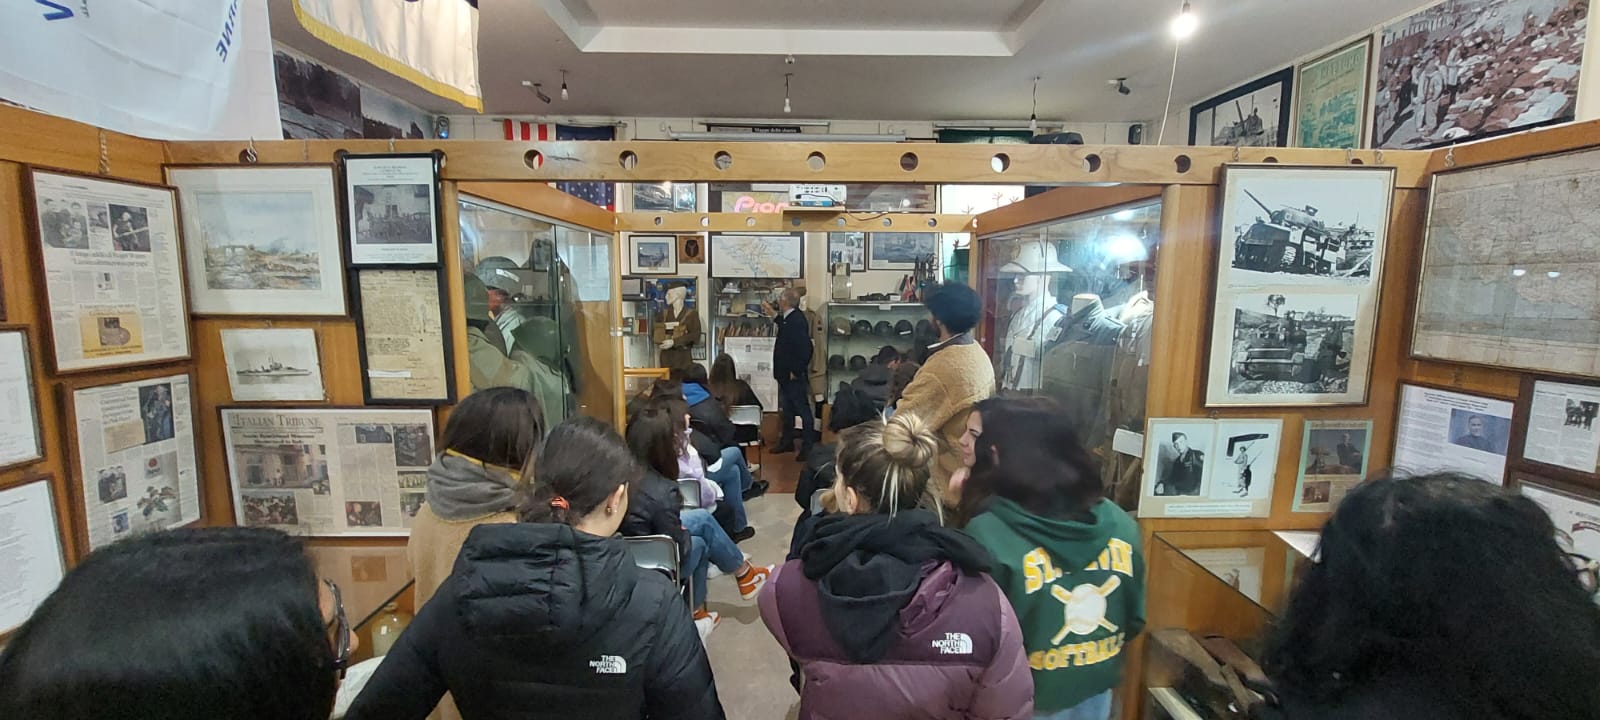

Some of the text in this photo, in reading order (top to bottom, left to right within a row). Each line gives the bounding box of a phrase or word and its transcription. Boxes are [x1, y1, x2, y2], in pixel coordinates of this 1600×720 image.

[276, 414, 320, 427] TRIBUNE
[932, 640, 960, 648] NORTH
[589, 660, 615, 668] NORTH
